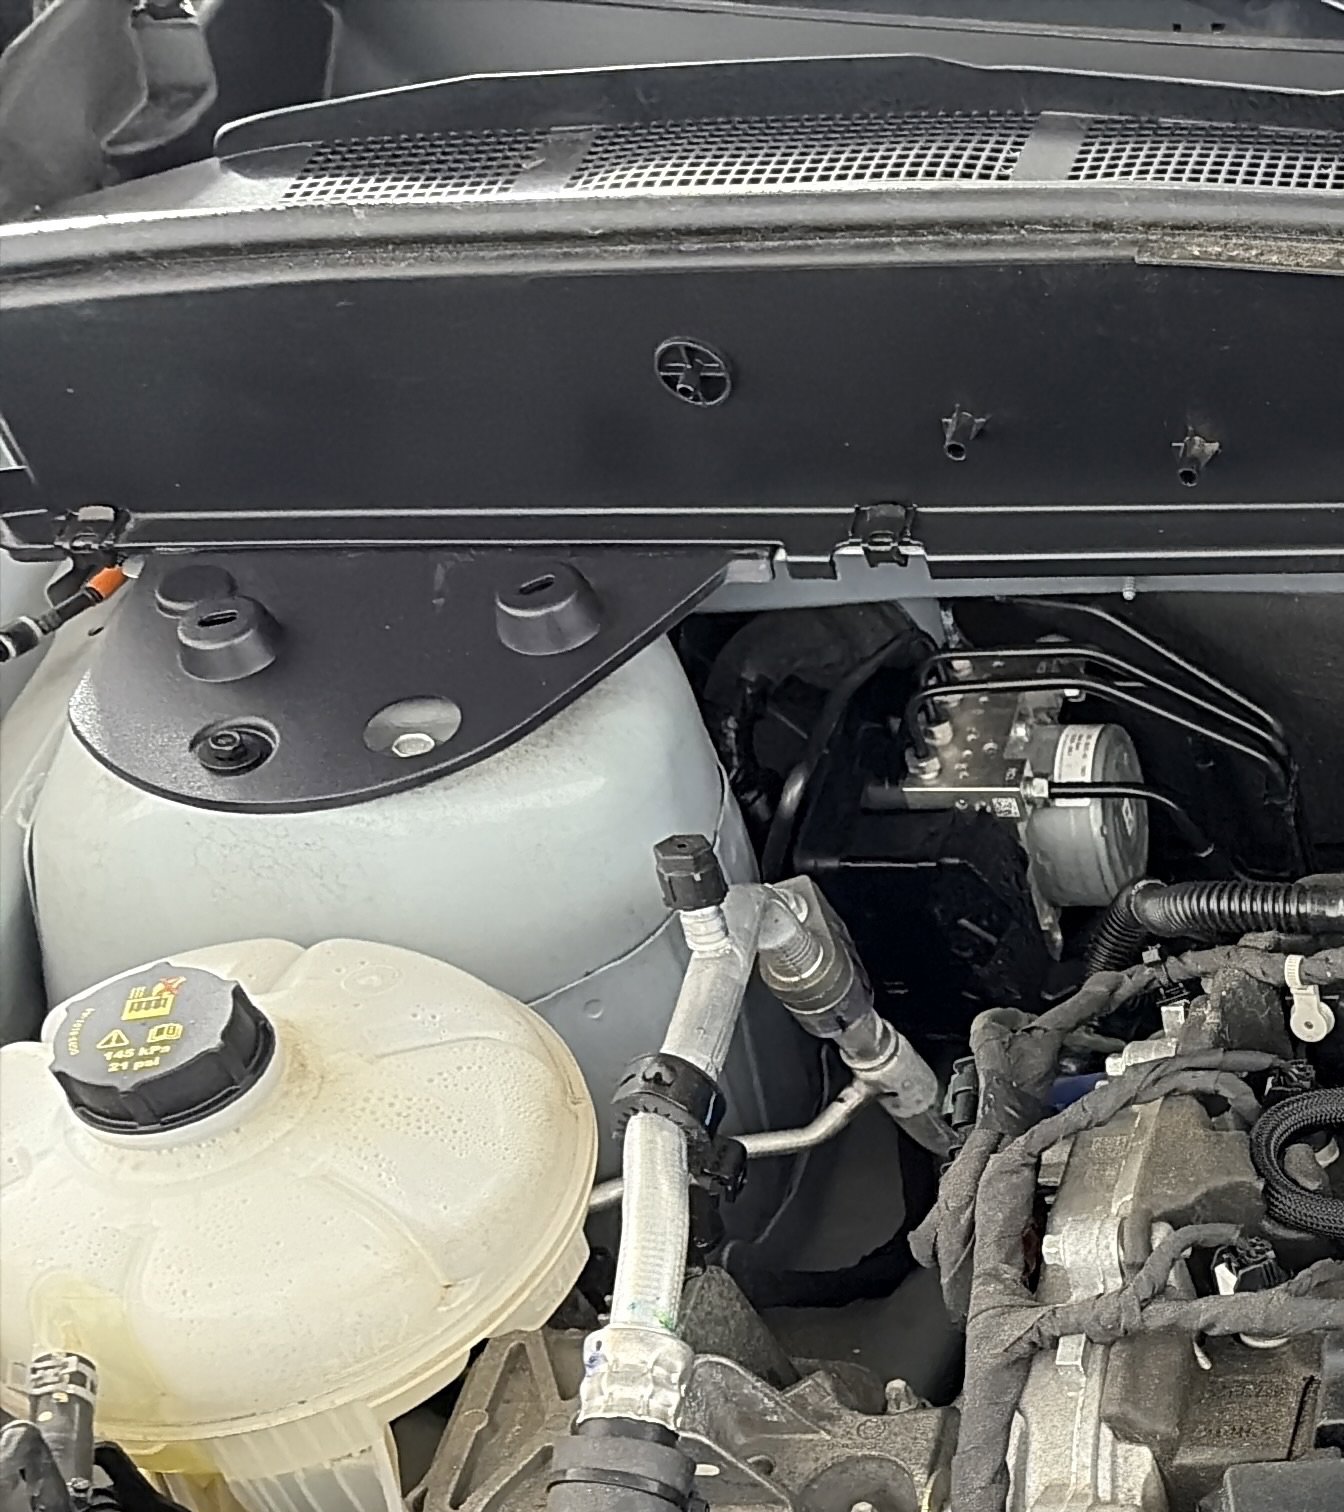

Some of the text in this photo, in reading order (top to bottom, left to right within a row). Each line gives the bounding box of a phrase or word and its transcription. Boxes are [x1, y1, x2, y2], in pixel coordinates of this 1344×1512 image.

[104, 1045, 171, 1061] 145 kPa
[108, 1057, 160, 1072] 21 psi
